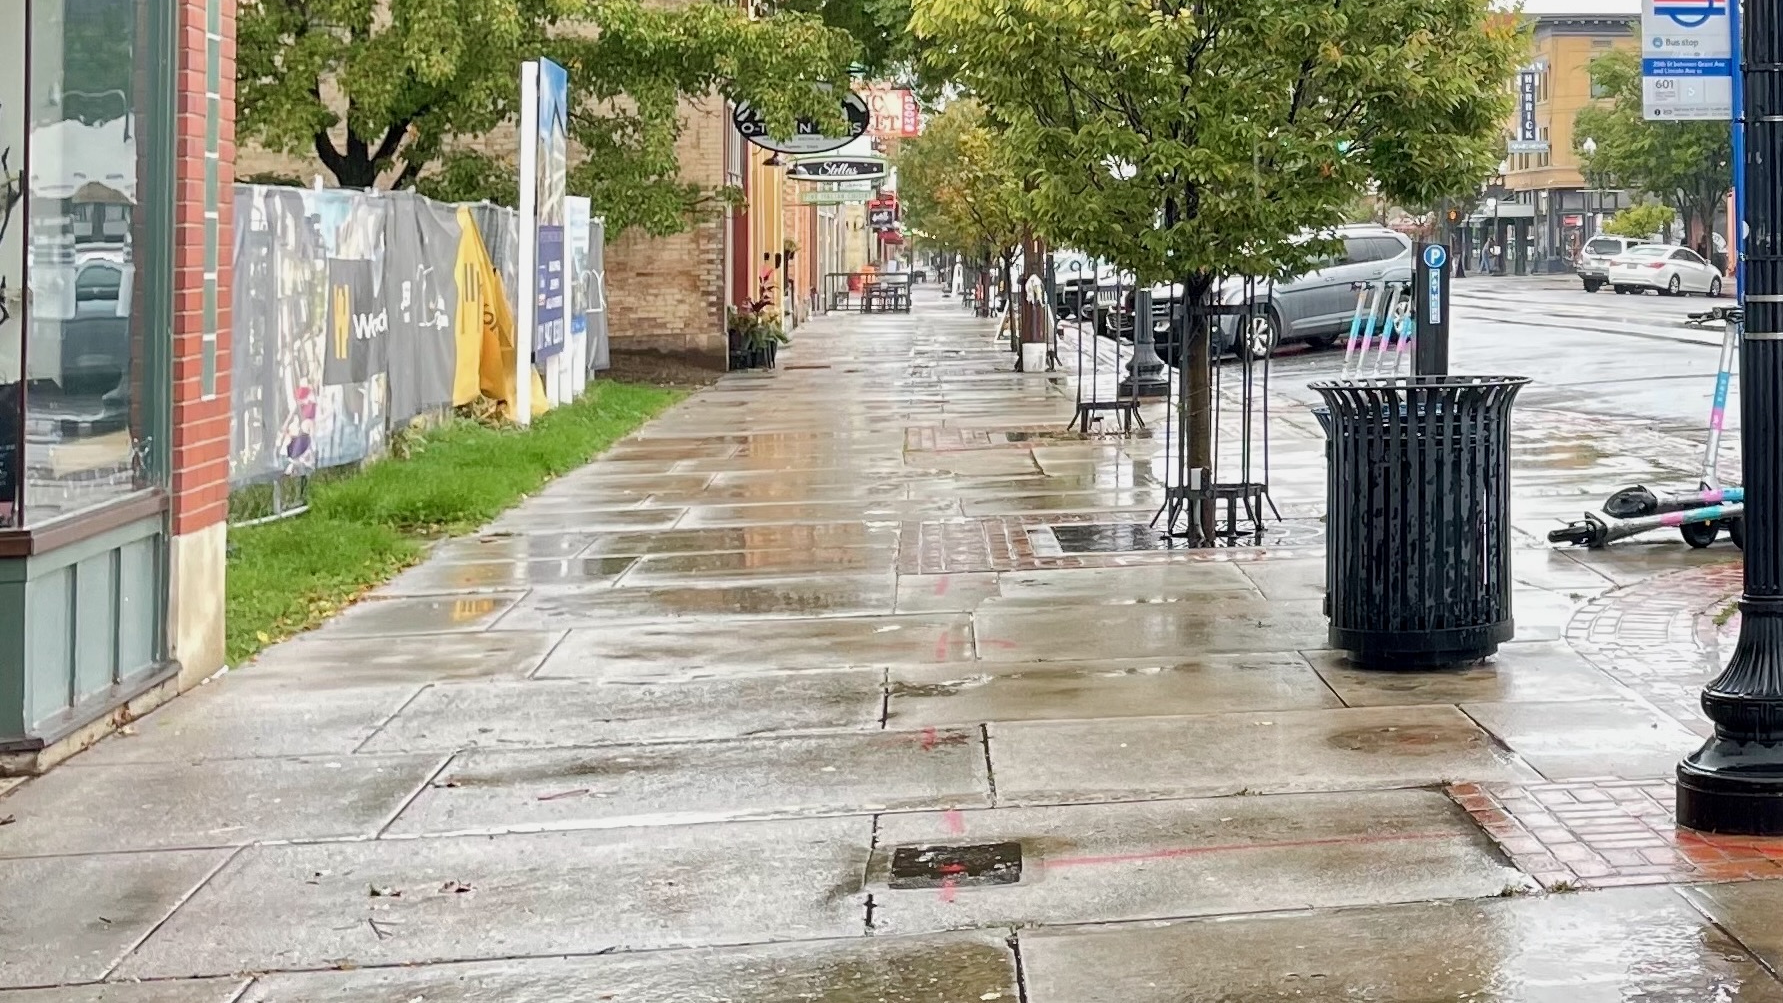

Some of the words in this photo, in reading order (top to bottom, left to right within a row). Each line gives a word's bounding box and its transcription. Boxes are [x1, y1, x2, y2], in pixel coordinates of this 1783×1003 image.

[1665, 37, 1680, 47] Bus
[1681, 37, 1699, 49] stop
[1655, 79, 1674, 89] 601
[1524, 74, 1534, 139] HERRICK
[741, 121, 812, 135] O-TN
[1430, 248, 1441, 265] P
